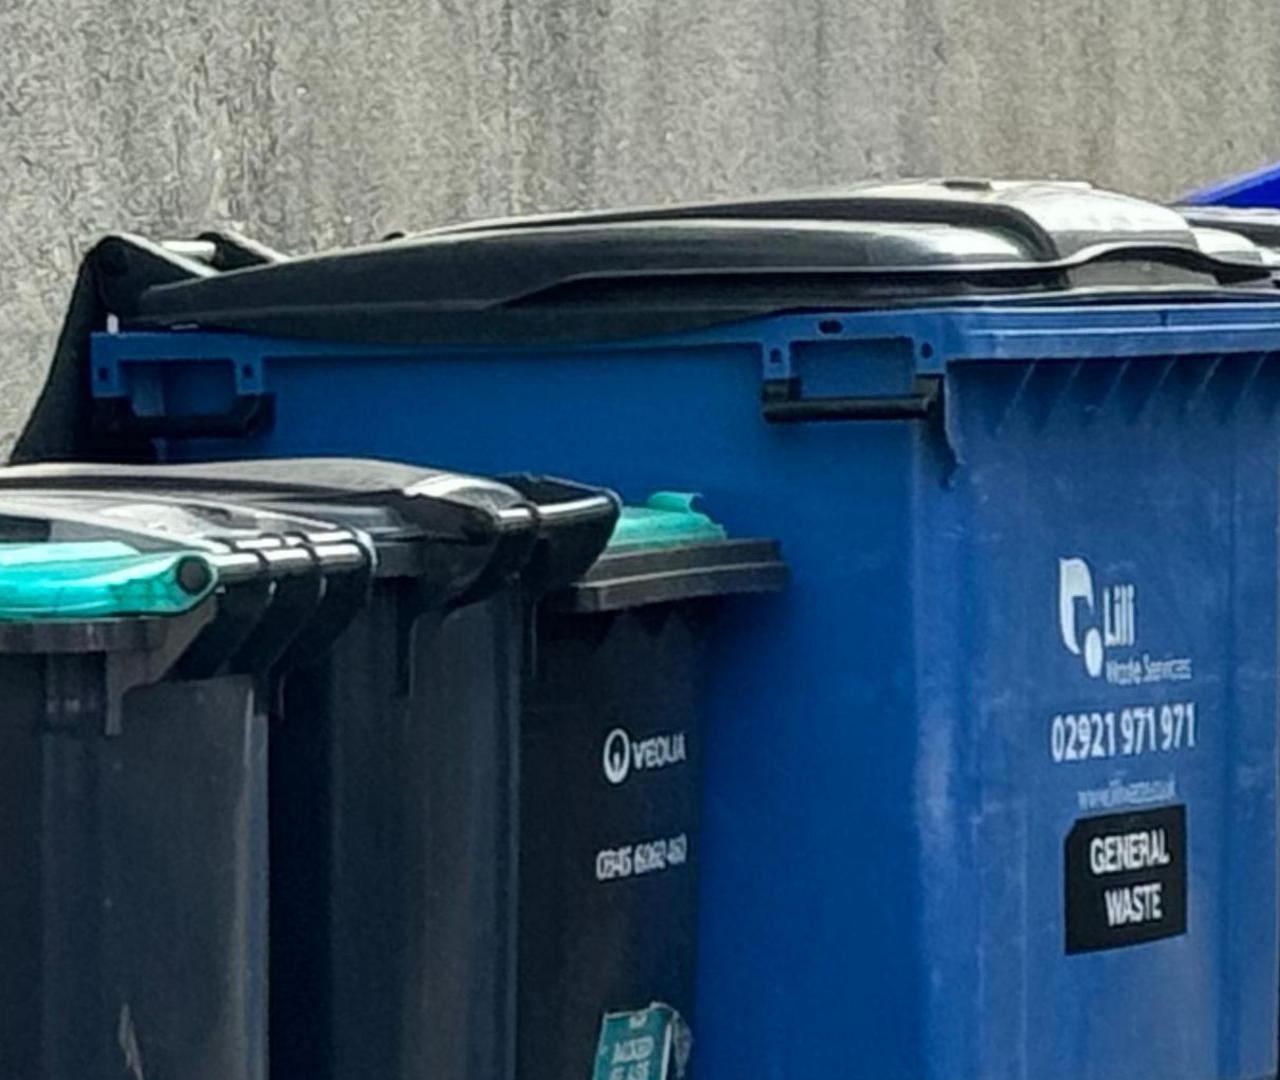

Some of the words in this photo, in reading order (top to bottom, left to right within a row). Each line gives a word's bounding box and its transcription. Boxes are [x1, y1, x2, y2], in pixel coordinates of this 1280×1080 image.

[631, 731, 687, 771] VEOLIA
[1051, 711, 1117, 764] 02921
[1120, 706, 1157, 756] 971
[1160, 702, 1196, 751] 971
[1090, 827, 1171, 875] GENERAL
[1104, 881, 1163, 927] WASTE
